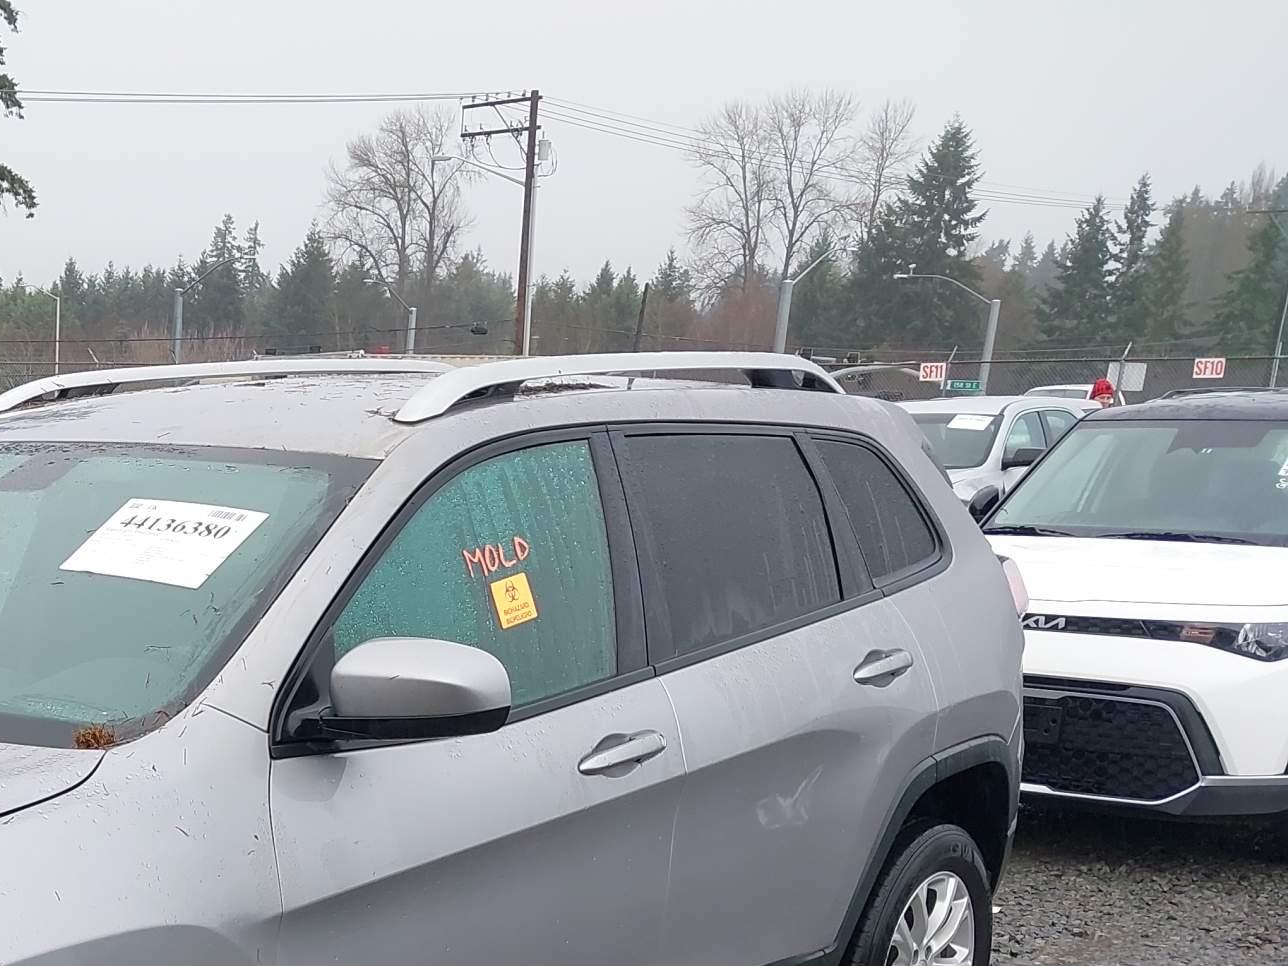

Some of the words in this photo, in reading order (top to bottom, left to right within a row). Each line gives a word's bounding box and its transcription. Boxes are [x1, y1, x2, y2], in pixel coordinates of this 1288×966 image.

[922, 364, 943, 379] SF11
[1195, 360, 1224, 376] SF10
[119, 514, 232, 539] 44136380
[462, 535, 530, 578] MOLD
